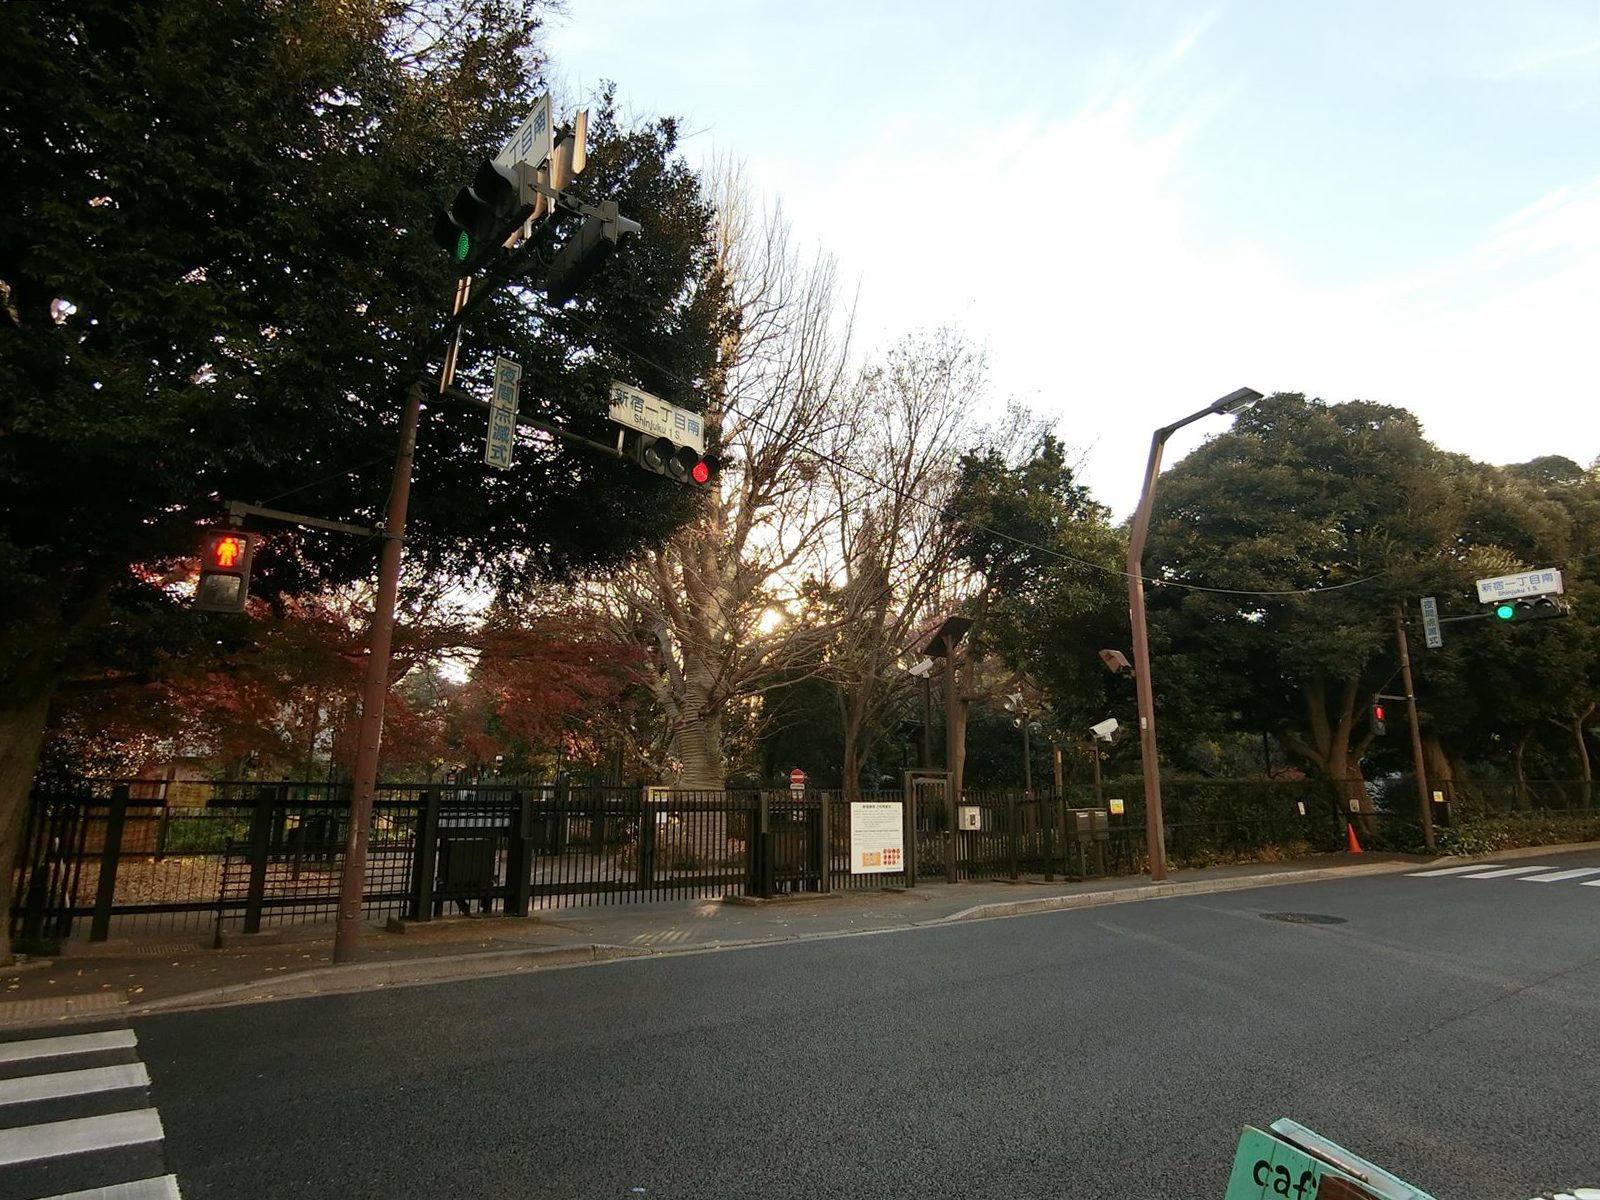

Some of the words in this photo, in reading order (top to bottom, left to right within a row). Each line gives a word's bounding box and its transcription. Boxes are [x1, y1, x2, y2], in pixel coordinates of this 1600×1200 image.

[507, 106, 547, 168] 丁目南
[490, 364, 517, 464] 夜間点滅式
[616, 389, 700, 437] 新宿一丁目南
[634, 413, 667, 435] Shinjuku
[1481, 572, 1554, 592] 新宿一丁目南
[1498, 588, 1525, 597] Shinjuku
[1253, 1160, 1317, 1200] caf
